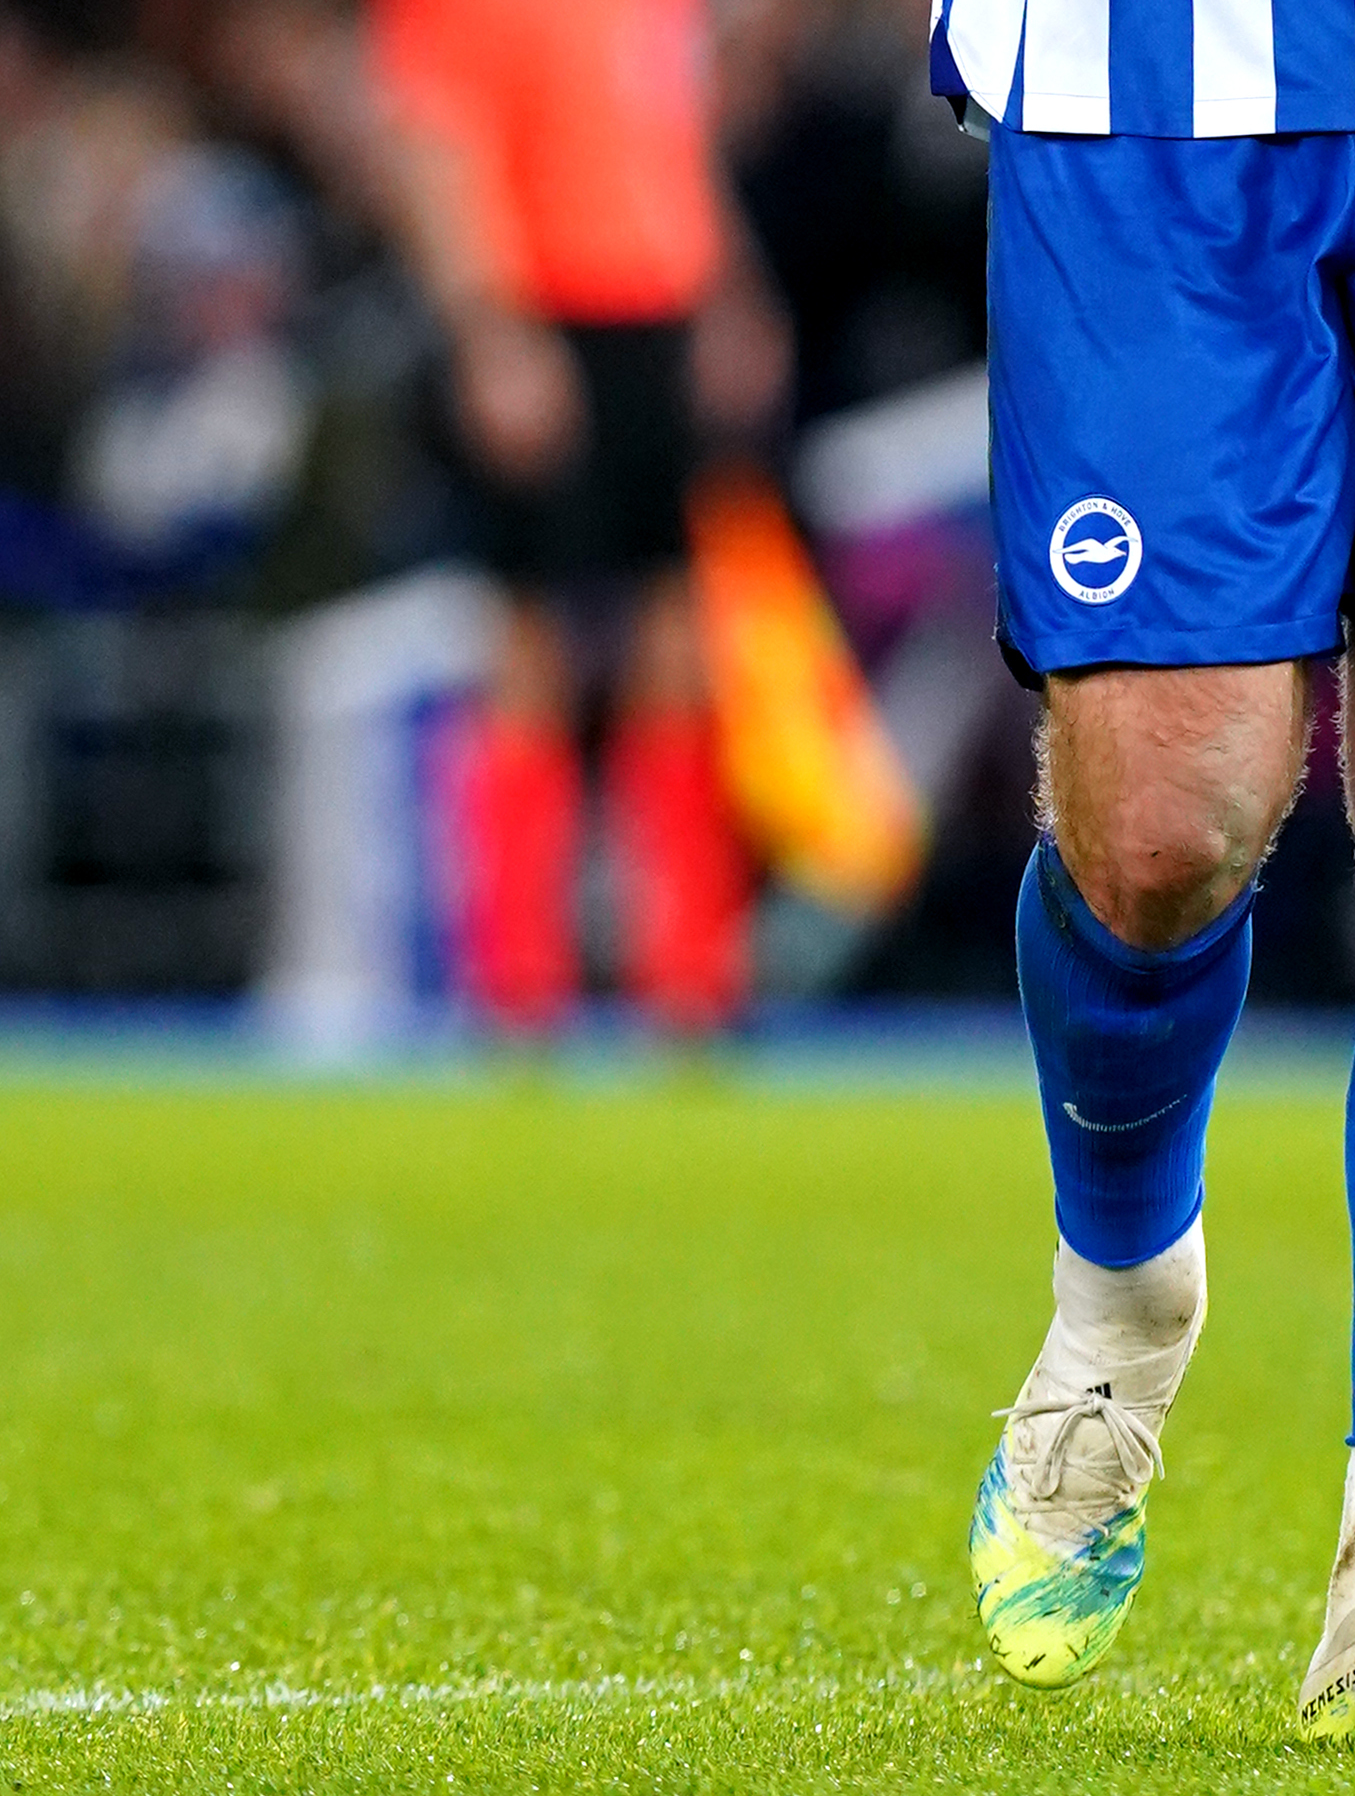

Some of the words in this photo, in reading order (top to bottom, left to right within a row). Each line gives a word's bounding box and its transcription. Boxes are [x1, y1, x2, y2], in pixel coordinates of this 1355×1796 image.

[1058, 501, 1098, 532] BRIGHTON
[1110, 506, 1132, 527] HOVE
[1078, 588, 1115, 600] ALBION
